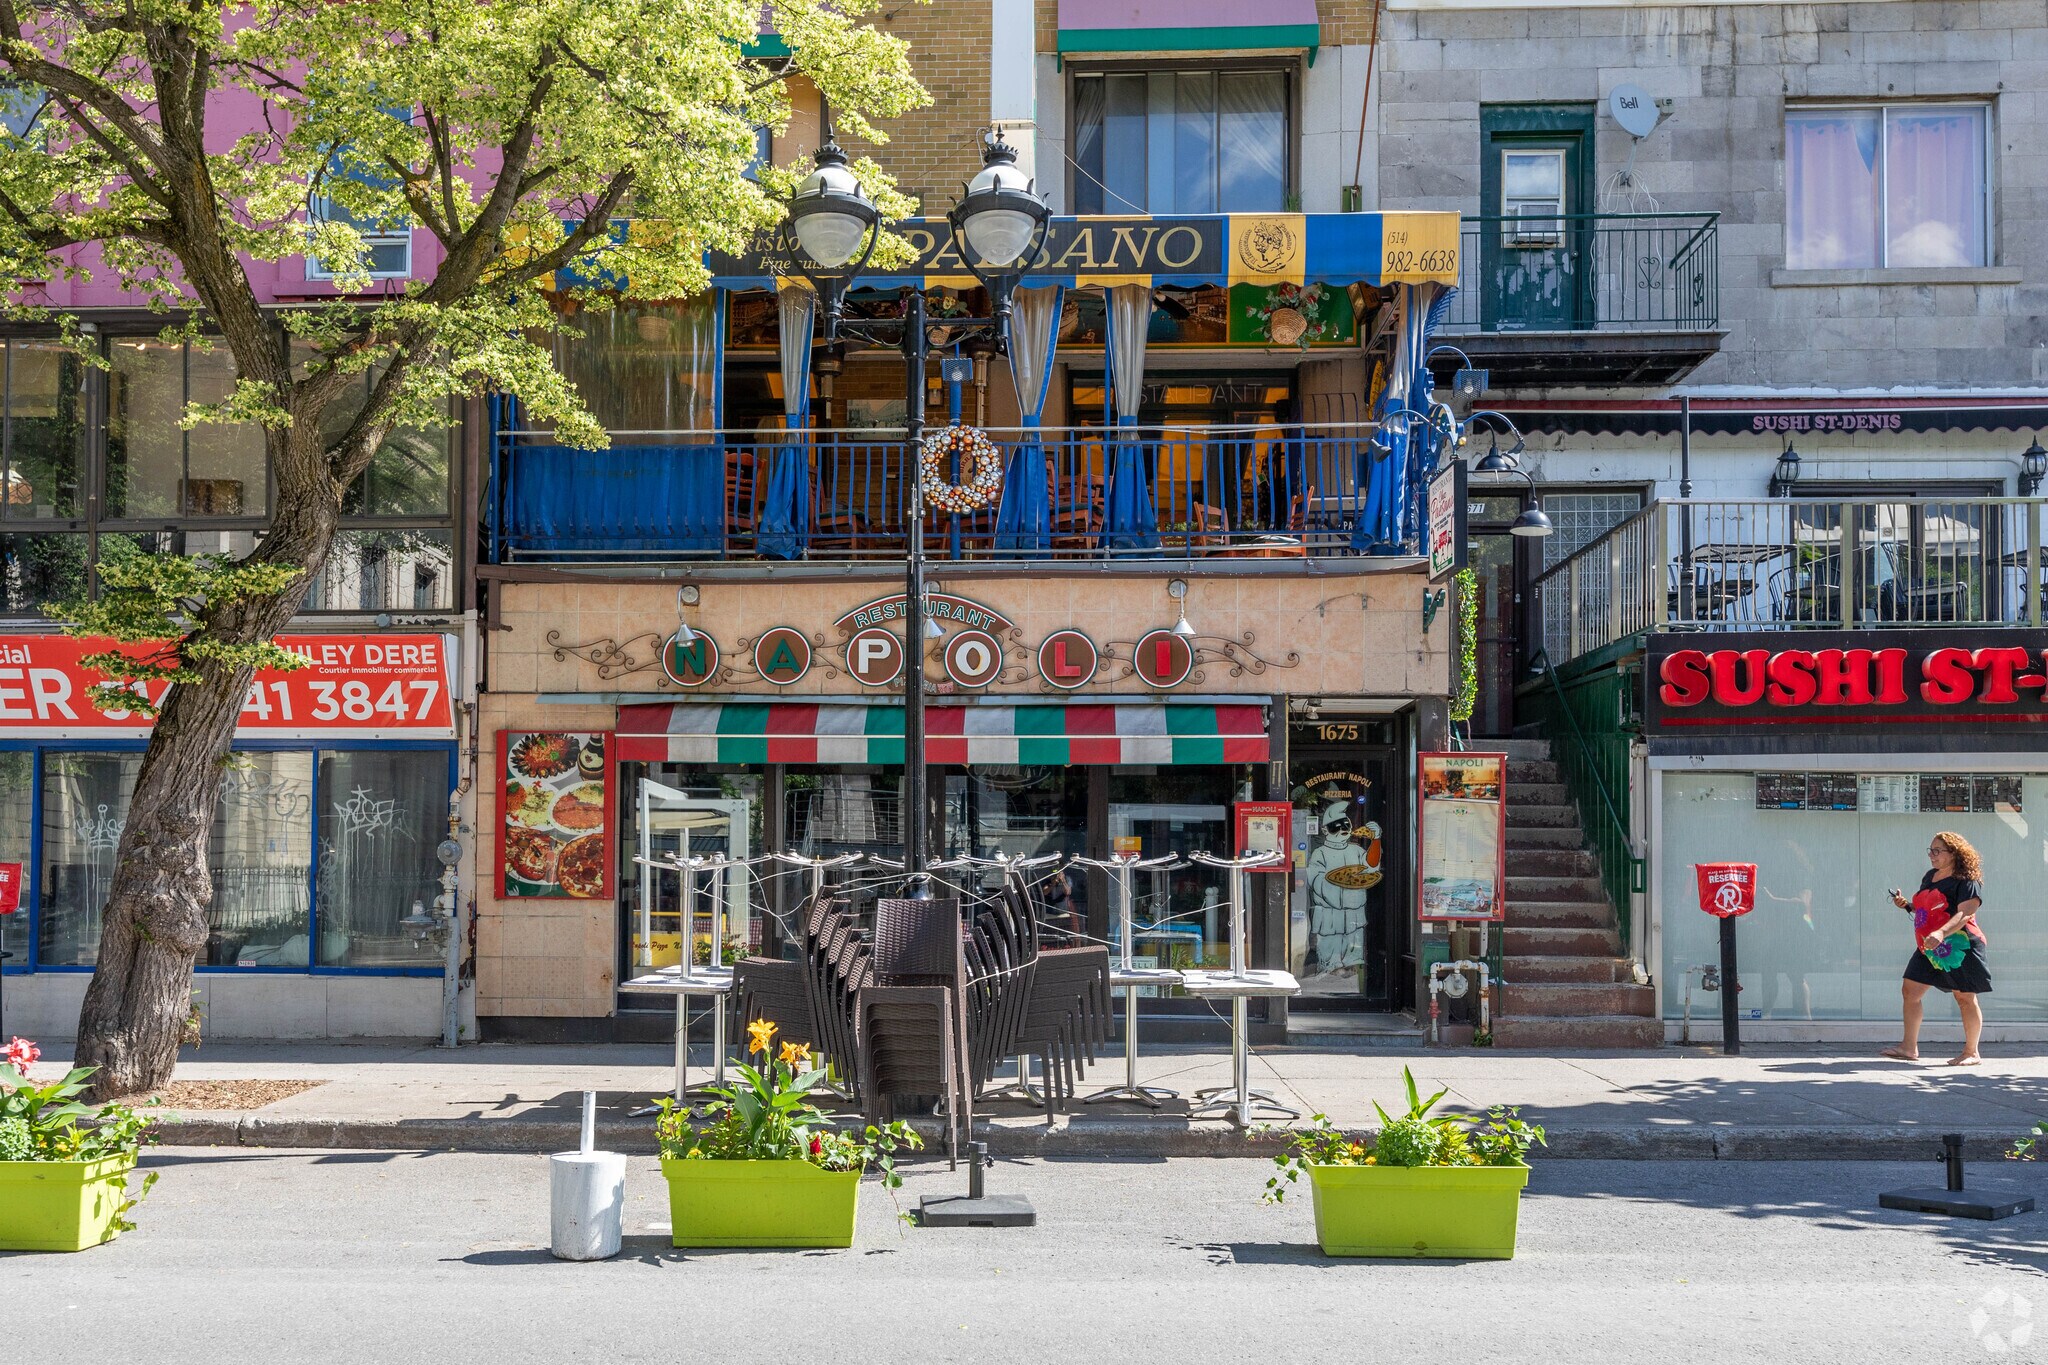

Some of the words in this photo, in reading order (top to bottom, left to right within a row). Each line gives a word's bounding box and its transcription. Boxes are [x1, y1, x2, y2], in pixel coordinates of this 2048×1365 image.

[1619, 97, 1639, 109] Bell
[1387, 231, 1408, 246] (514)
[898, 226, 1203, 269] PASANO
[758, 256, 791, 269] Fine
[1386, 249, 1456, 272] 982-6638
[1097, 384, 1263, 403] RSTAURANT
[1752, 415, 1811, 430] SUSHI
[1814, 414, 1901, 429] ST-DENIS
[853, 600, 996, 631] RESTURANT
[365, 645, 436, 664] DERE
[675, 638, 1171, 678] NAPOLI
[318, 666, 350, 674] Courtier
[351, 666, 392, 674] immobilier
[393, 666, 437, 674] commercial
[1659, 648, 1908, 707] SUSHI
[1920, 646, 2048, 705] ST-
[308, 680, 439, 721] 3847
[1317, 724, 1358, 740] 1675
[1446, 759, 1483, 767] NAPOLI
[1305, 772, 1346, 789] RESTAURANT
[1348, 773, 1372, 788] NAPOLI
[1324, 790, 1352, 798] PIZZERIA
